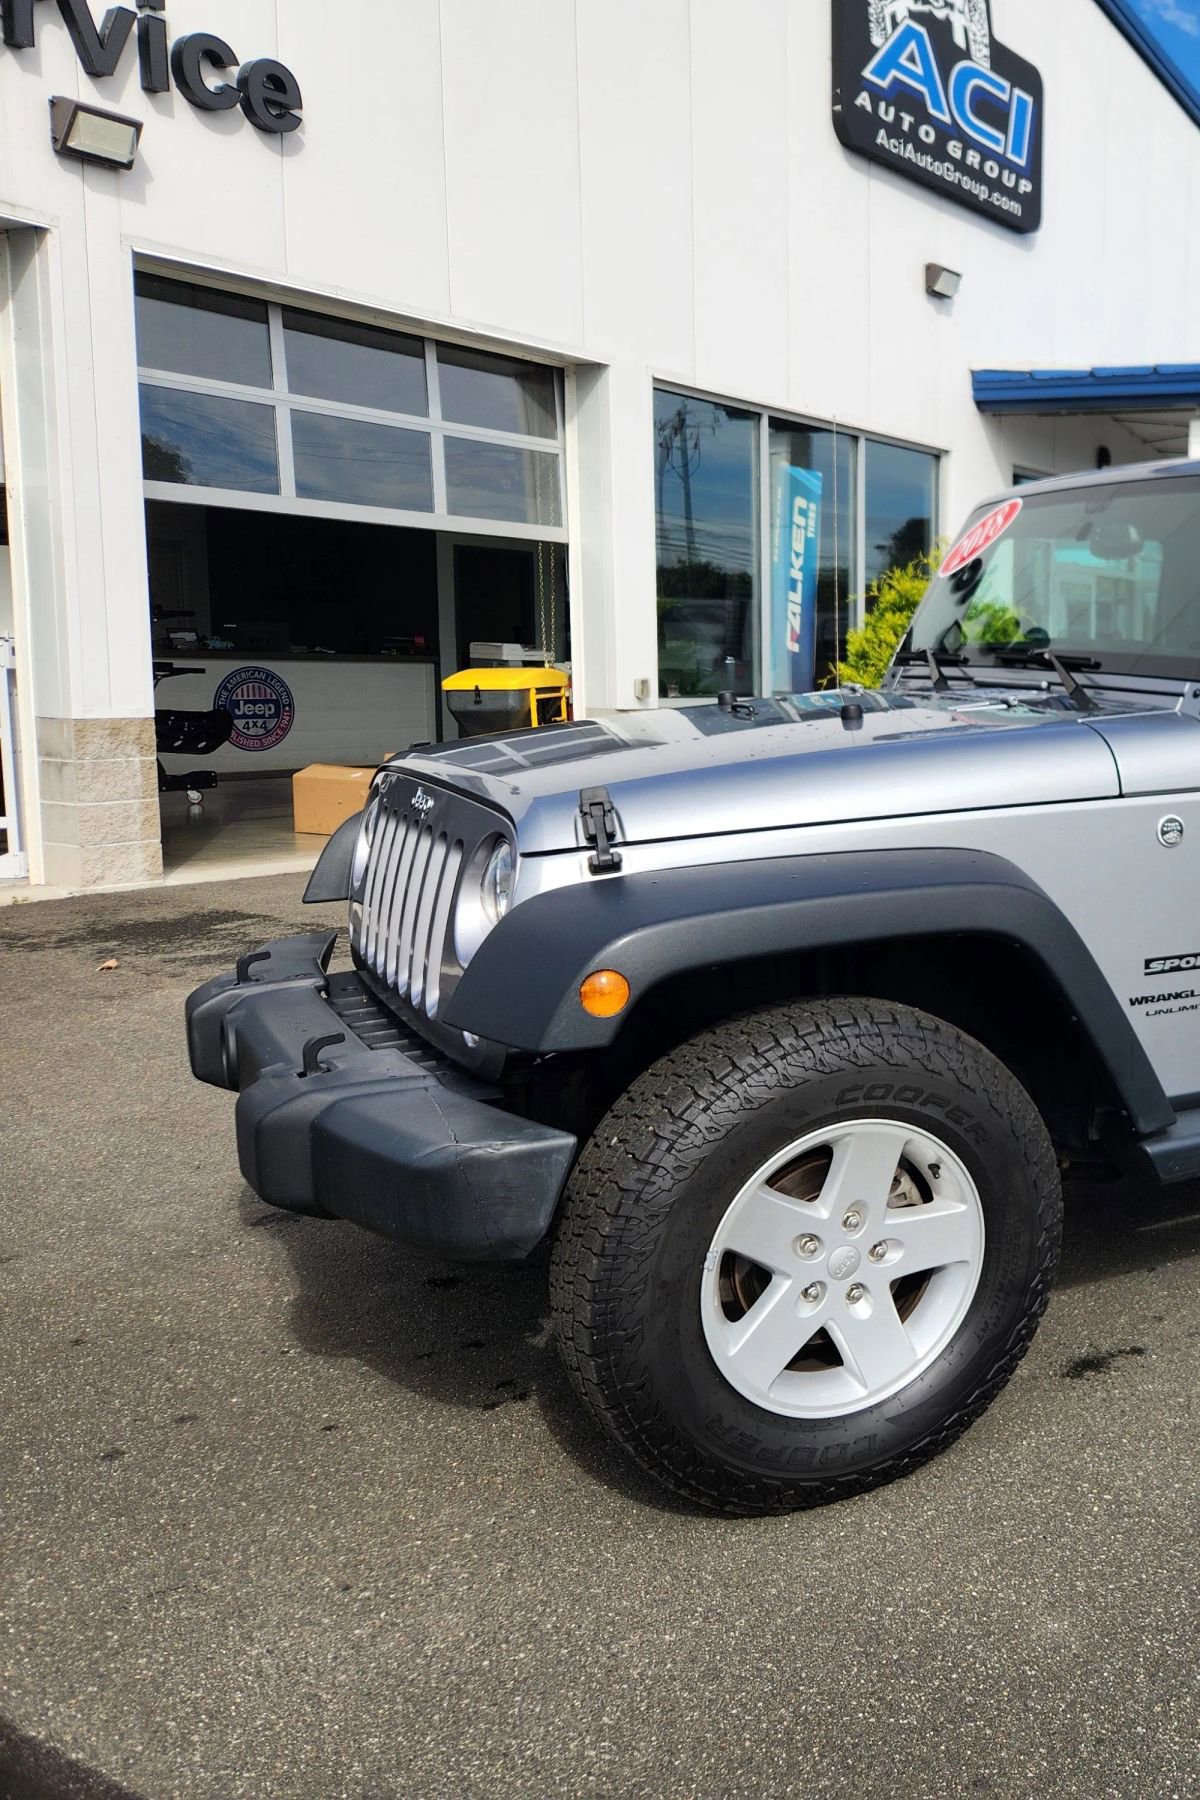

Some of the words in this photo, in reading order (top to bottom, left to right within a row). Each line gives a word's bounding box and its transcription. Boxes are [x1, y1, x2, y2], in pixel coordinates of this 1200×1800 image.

[861, 17, 1034, 168] ACI
[854, 90, 936, 144] AUTO
[946, 140, 1033, 195] GROUP
[875, 128, 1022, 217] AciAutoGroup.com
[219, 690, 229, 705] THE
[227, 671, 266, 691] AMERICAN
[267, 676, 290, 705] LEGEND
[234, 700, 275, 717] Jeep
[262, 729, 284, 746] SINCE
[281, 712, 292, 728] 1941
[835, 1083, 992, 1145] COOPER
